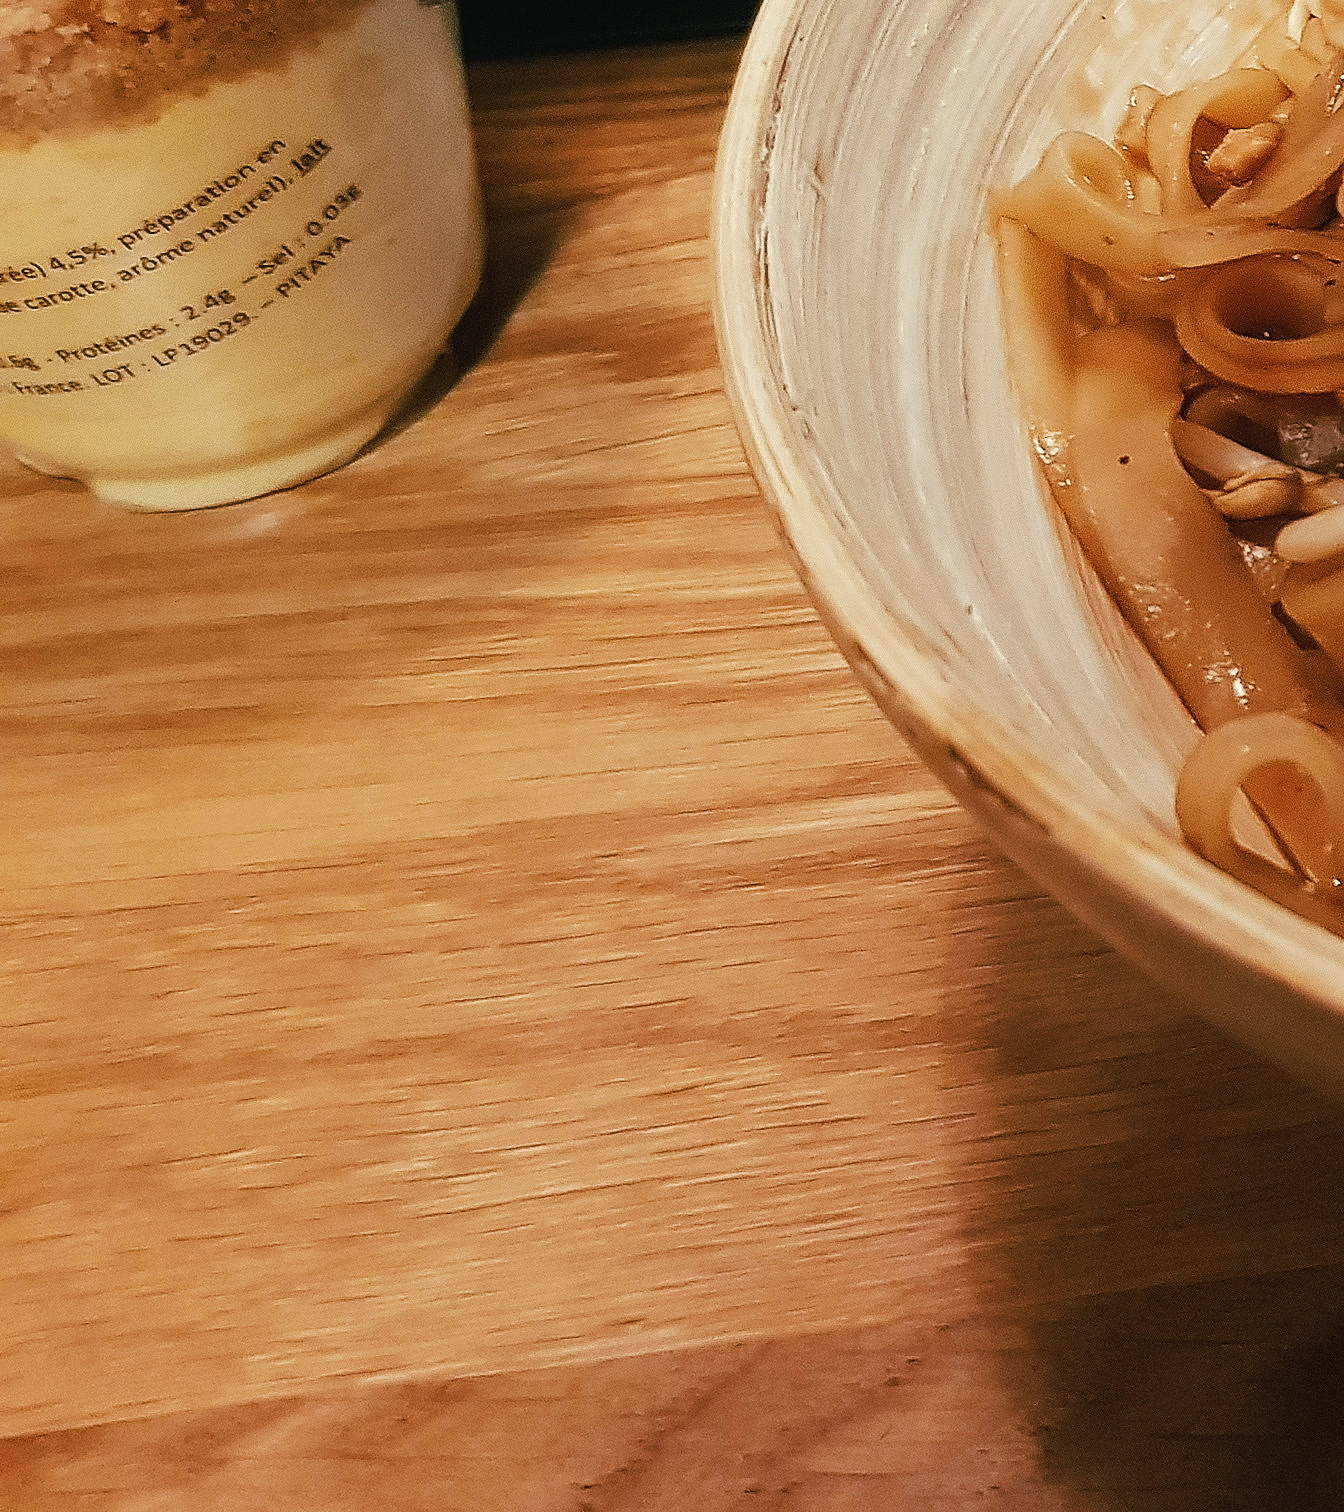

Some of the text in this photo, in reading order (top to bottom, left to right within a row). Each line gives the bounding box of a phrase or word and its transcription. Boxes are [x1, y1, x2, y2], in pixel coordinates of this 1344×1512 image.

[117, 163, 257, 250] préparation
[256, 140, 286, 164] en
[55, 323, 167, 363] Protéines
[256, 245, 295, 275] Sel
[90, 363, 136, 387] LOT
[275, 236, 352, 299] PITAYA
[116, 240, 195, 282] arôme
